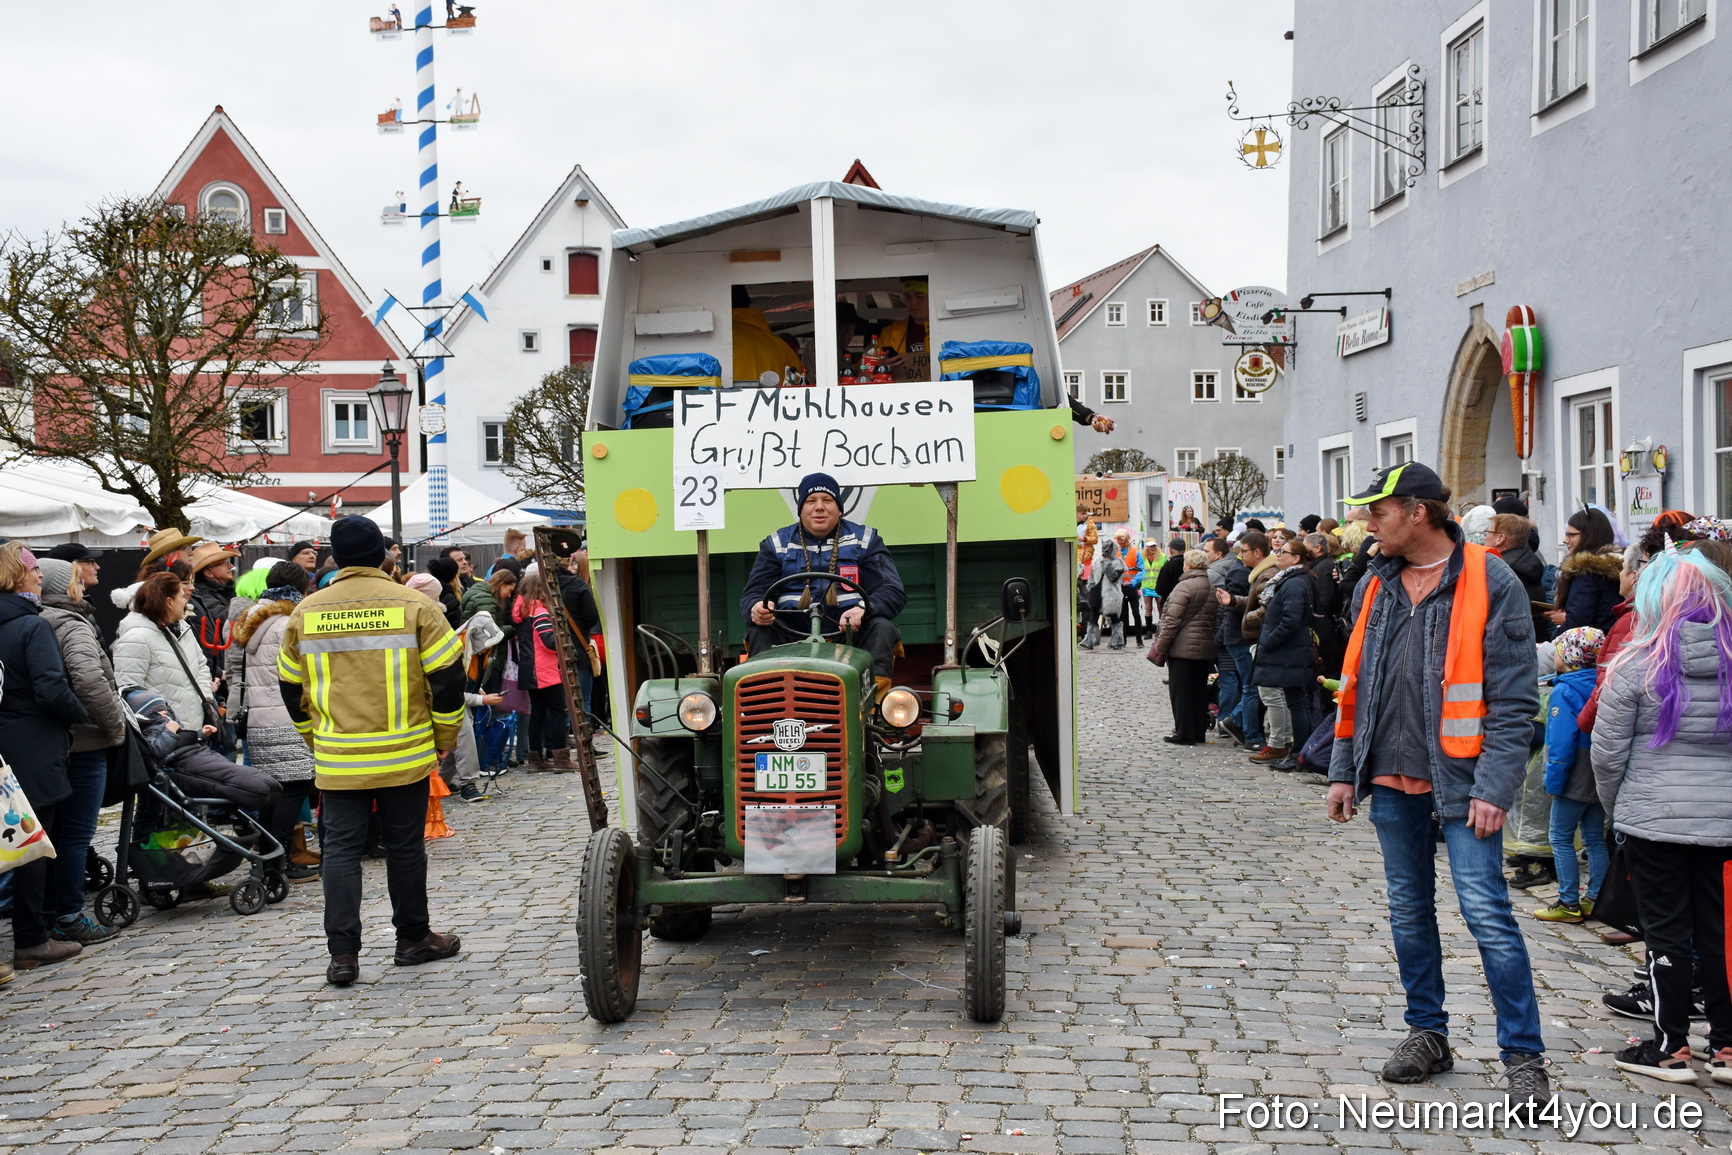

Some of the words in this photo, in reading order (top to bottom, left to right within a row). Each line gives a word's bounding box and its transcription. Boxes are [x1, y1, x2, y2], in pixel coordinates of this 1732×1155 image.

[1237, 288, 1272, 297] Pizzeria
[1245, 301, 1265, 309] Café
[1345, 332, 1359, 350] Bella
[1361, 329, 1378, 345] Roma
[681, 389, 744, 426] FF
[748, 387, 954, 422] Mühlhausen
[691, 423, 801, 483] Grüßt
[822, 427, 965, 467] Bacham
[680, 475, 717, 507] 23
[1640, 487, 1652, 500] Eis
[1630, 503, 1658, 516] Kuchen
[321, 609, 385, 621] FEUERWEHR
[316, 620, 390, 632] MÜHLHAUSEN
[779, 725, 800, 737] HELA
[772, 756, 794, 771] NM
[766, 773, 788, 789] LD
[796, 774, 816, 789] 55
